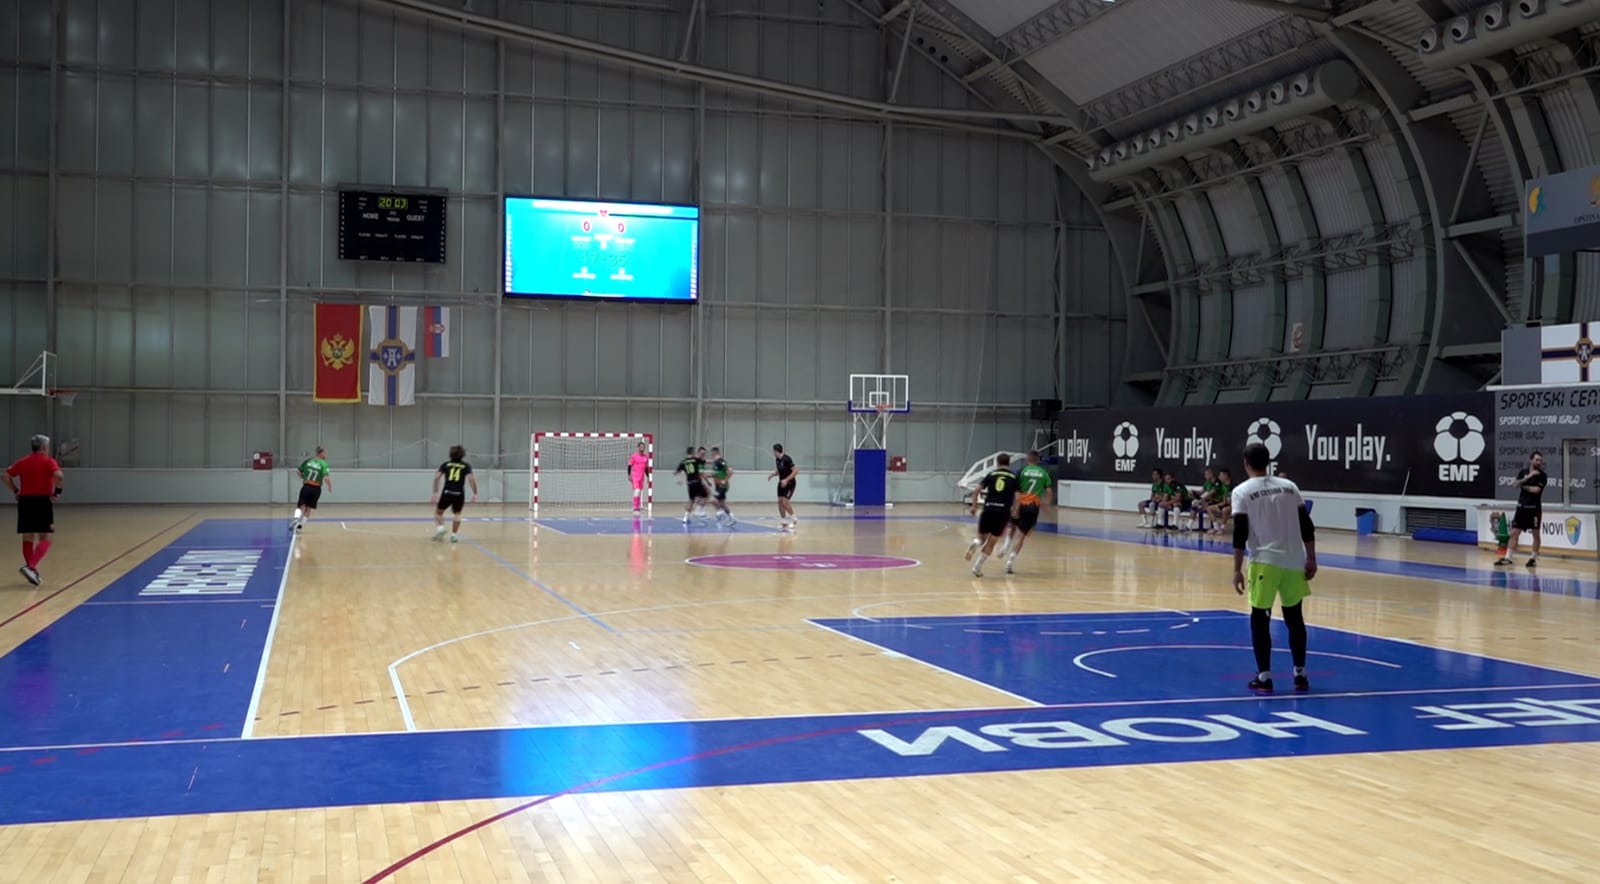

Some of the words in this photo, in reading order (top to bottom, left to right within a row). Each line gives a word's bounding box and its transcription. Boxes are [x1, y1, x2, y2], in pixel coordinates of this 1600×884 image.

[362, 212, 379, 220] HOME
[406, 214, 425, 222] GUEST
[583, 220, 590, 231] 0
[618, 222, 625, 233] 0
[1501, 391, 1565, 410] SPORTSKI
[1570, 389, 1600, 408] CEN
[1499, 415, 1530, 426] SPORTSKI
[1559, 414, 1580, 425] IGALO
[1067, 429, 1092, 464] play.
[1155, 427, 1179, 459] You
[1184, 427, 1217, 466] play.
[1305, 424, 1339, 460] You
[1345, 424, 1391, 470] play.
[1115, 459, 1136, 472] EMF
[306, 468, 319, 481] 77
[448, 467, 461, 482] 14
[1438, 464, 1480, 482] EMF
[995, 476, 1006, 493] 6
[1028, 478, 1037, 495] 7
[1542, 522, 1564, 536] NOVI
